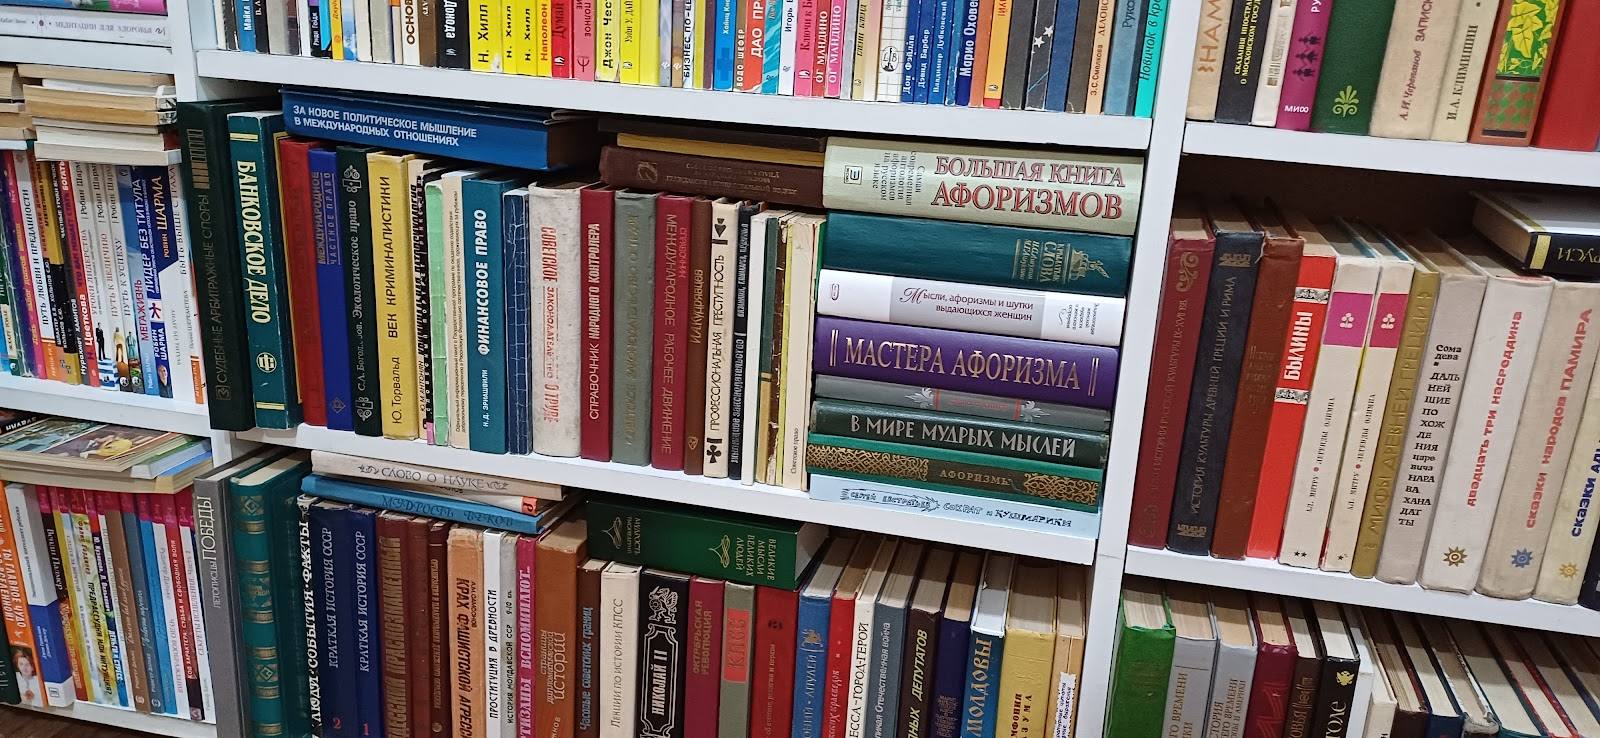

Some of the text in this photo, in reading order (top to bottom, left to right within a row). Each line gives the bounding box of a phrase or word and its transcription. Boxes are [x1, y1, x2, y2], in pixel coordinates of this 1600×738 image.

[478, 4, 489, 63] Н. Хилл
[540, 3, 549, 62] Наполеон
[584, 2, 592, 37] ПОЛНОЕ
[785, 8, 794, 32] Игорь
[816, 11, 828, 65] МАНДИНО
[736, 29, 745, 87] БОДО ШЕФЕР
[751, 28, 764, 58] ДАО
[828, 5, 841, 83] ОГ МАНДИНО
[917, 29, 931, 88] Дэвид Барбер
[1452, 24, 1478, 95] КЛИМИШИН
[1404, 50, 1422, 98] Черепанов
[293, 106, 477, 138] ЗА НОВОЕ ПОЛИТИЧЕСКОЕ МЫШЛЕНИЕ
[1400, 110, 1408, 120] А.
[1402, 100, 1411, 109] И.
[294, 117, 460, 146] В МЕЖДУНАРОДНЫХ ОТНОШЕНИЯХ
[933, 155, 1127, 188] БОЛЬШАЯ КНИГА
[79, 191, 89, 215] Робин
[131, 179, 146, 226] ТИТУЛА
[151, 176, 170, 257] РОБИН ШАРМА
[324, 172, 337, 265] ЧАСТНОЕ ПРАВО
[930, 177, 1123, 221] АФОРИЗМОВ
[21, 189, 39, 254] ПРЕДАННОСТИ
[139, 228, 150, 249] БЕЗ
[236, 160, 271, 323] БАНКОВСКОЕ ДЕЛО
[474, 209, 487, 255] ПРАВО
[80, 229, 94, 281] ЛИДЕРСТВА
[142, 253, 155, 293] ЛИДЕР
[1040, 241, 1057, 282] СЛОВА
[32, 267, 46, 300] ЛЮБВИ
[89, 284, 98, 315] УРОКИ
[379, 176, 403, 423] Ю. Торвальд ВЕК КРИМИНАЛИСТИКИ
[900, 287, 947, 304] Мысли,
[949, 293, 996, 307] афоризмы
[1006, 299, 1034, 311] шутки
[38, 302, 49, 325] ПУТЬ
[134, 279, 149, 341] МЕГАЖИЗНЬ
[475, 262, 490, 355] ФИНАНСОВОЕ
[587, 223, 600, 420] СПРАВОЧНИК НАРОДНОГО КОНТРОЛЕРА
[935, 304, 1032, 321] выдающихся женщин
[151, 329, 159, 358] РОБИН
[157, 328, 167, 360] ШАРМА
[661, 214, 678, 454] МЕЖДУНАРОДНОЕ РАБОЧЕЕ ДВИЖЕНИЕ
[709, 254, 725, 431] ПРОФЕССИОНАЛЬНАЯ ПРЕСТУПНОСТЬ
[1284, 311, 1312, 381] БЫЛИНЫ
[1436, 345, 1462, 353] Сома
[845, 337, 1080, 390] МАСТЕРА АФОРИЗМА
[1430, 372, 1460, 382] ДАЛЬ
[481, 369, 489, 411] ЭРИАШВИЛИ
[1190, 276, 1237, 514] ИСТОРИЯ КУЛЬТУРЫ ДРЕВНЕЙ ГРЕЦИИ И РИМА
[1425, 396, 1451, 404] ШИЕ
[1427, 384, 1451, 393] НЕЙ
[1420, 420, 1445, 429] ХОЖ
[1422, 408, 1438, 416] ПО
[1525, 308, 1592, 529] сказки народов ПАМИРА
[851, 415, 1076, 458] В МИРЕ МУДРЫХ МЫСЛЕЙ
[1415, 443, 1439, 452] НИЯ
[381, 467, 486, 490] СЛОВО О НАУКЕ
[1405, 486, 1420, 494] ВА
[1408, 474, 1435, 483] НАРА
[1398, 518, 1414, 527] ТЫ
[1402, 497, 1432, 506] ХАНА
[1570, 477, 1597, 537] сказки
[197, 495, 221, 609] ЛЕТОПИСЦЫ ПОБЕДЫ
[736, 536, 745, 571] ЛЮДЕЙ
[746, 535, 755, 576] ВЕЛИКИХ
[757, 540, 765, 575] МЫСЛИ
[767, 538, 776, 580] ВЕЛИКИЕ
[2, 548, 27, 628] ТЫ ГЛАВНОЕ ЧУДО
[173, 559, 182, 596] СВОБОДНАЯ
[322, 528, 339, 668] КРАТКАЯ ИСТОРИЯ СССР
[179, 605, 187, 628] СУДЬБА
[355, 531, 370, 672] КРАТКАЯ ИСТОРИЯ СССР
[488, 589, 497, 642] ДРЕВНОСТИ
[184, 632, 192, 664] ХАРАКТЕРА:
[692, 600, 703, 674] ОКТЯБРЬСКАЯ
[702, 610, 712, 675] РЕВОЛЮЦИЯ
[506, 641, 514, 691] МОЛДАВСКОЙ
[546, 631, 554, 704] дипломатической
[580, 607, 594, 730] Часовые советских границ
[875, 622, 891, 712] Отечественная война
[966, 637, 992, 737] МОЛДОВЫ
[489, 657, 499, 719] ПРОСТИТУЦИЯ
[1171, 672, 1188, 721] ВРЕМЕНИ
[1235, 680, 1246, 714] АМЕРИКИ
